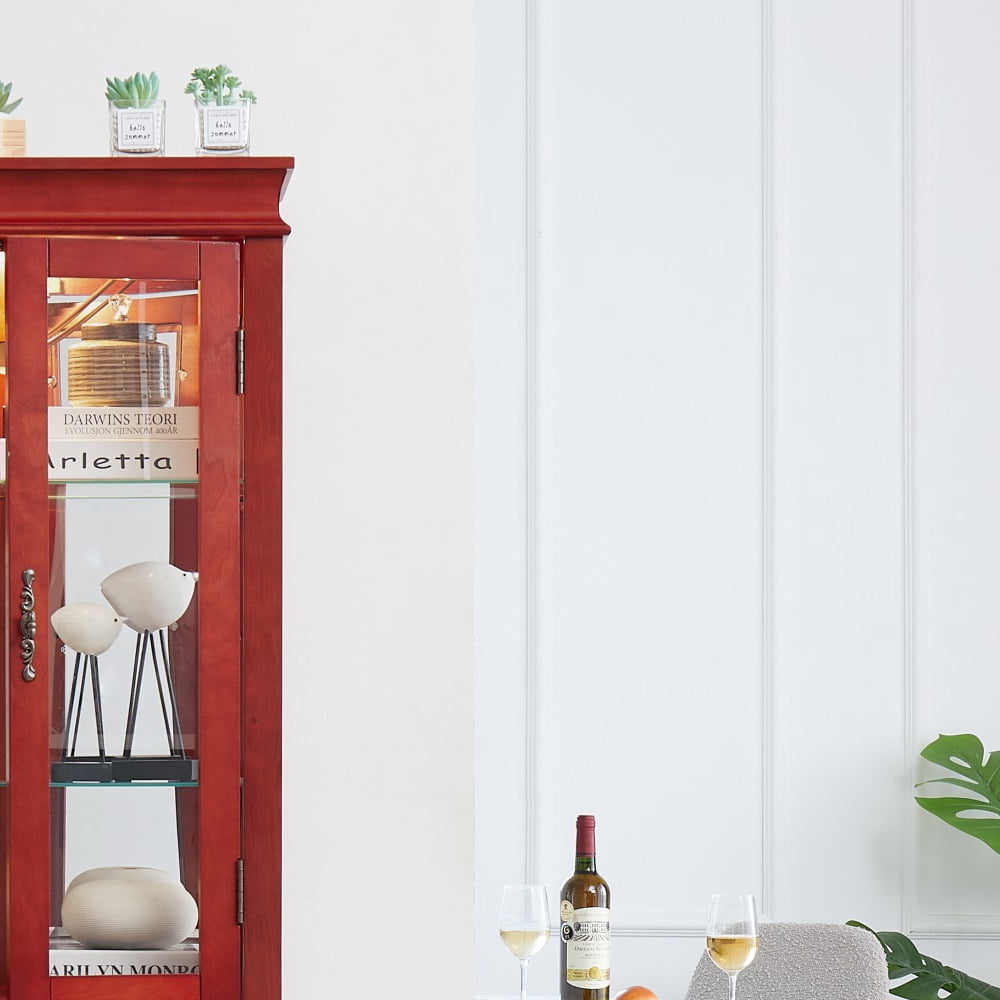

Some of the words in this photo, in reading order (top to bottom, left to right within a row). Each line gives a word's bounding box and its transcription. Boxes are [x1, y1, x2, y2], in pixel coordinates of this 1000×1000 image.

[64, 413, 131, 426] DARWINS
[134, 413, 178, 425] TEORI
[64, 427, 111, 436] EVOLUSJON
[113, 427, 153, 436] GJENNOM
[50, 964, 123, 976] ARILYN
